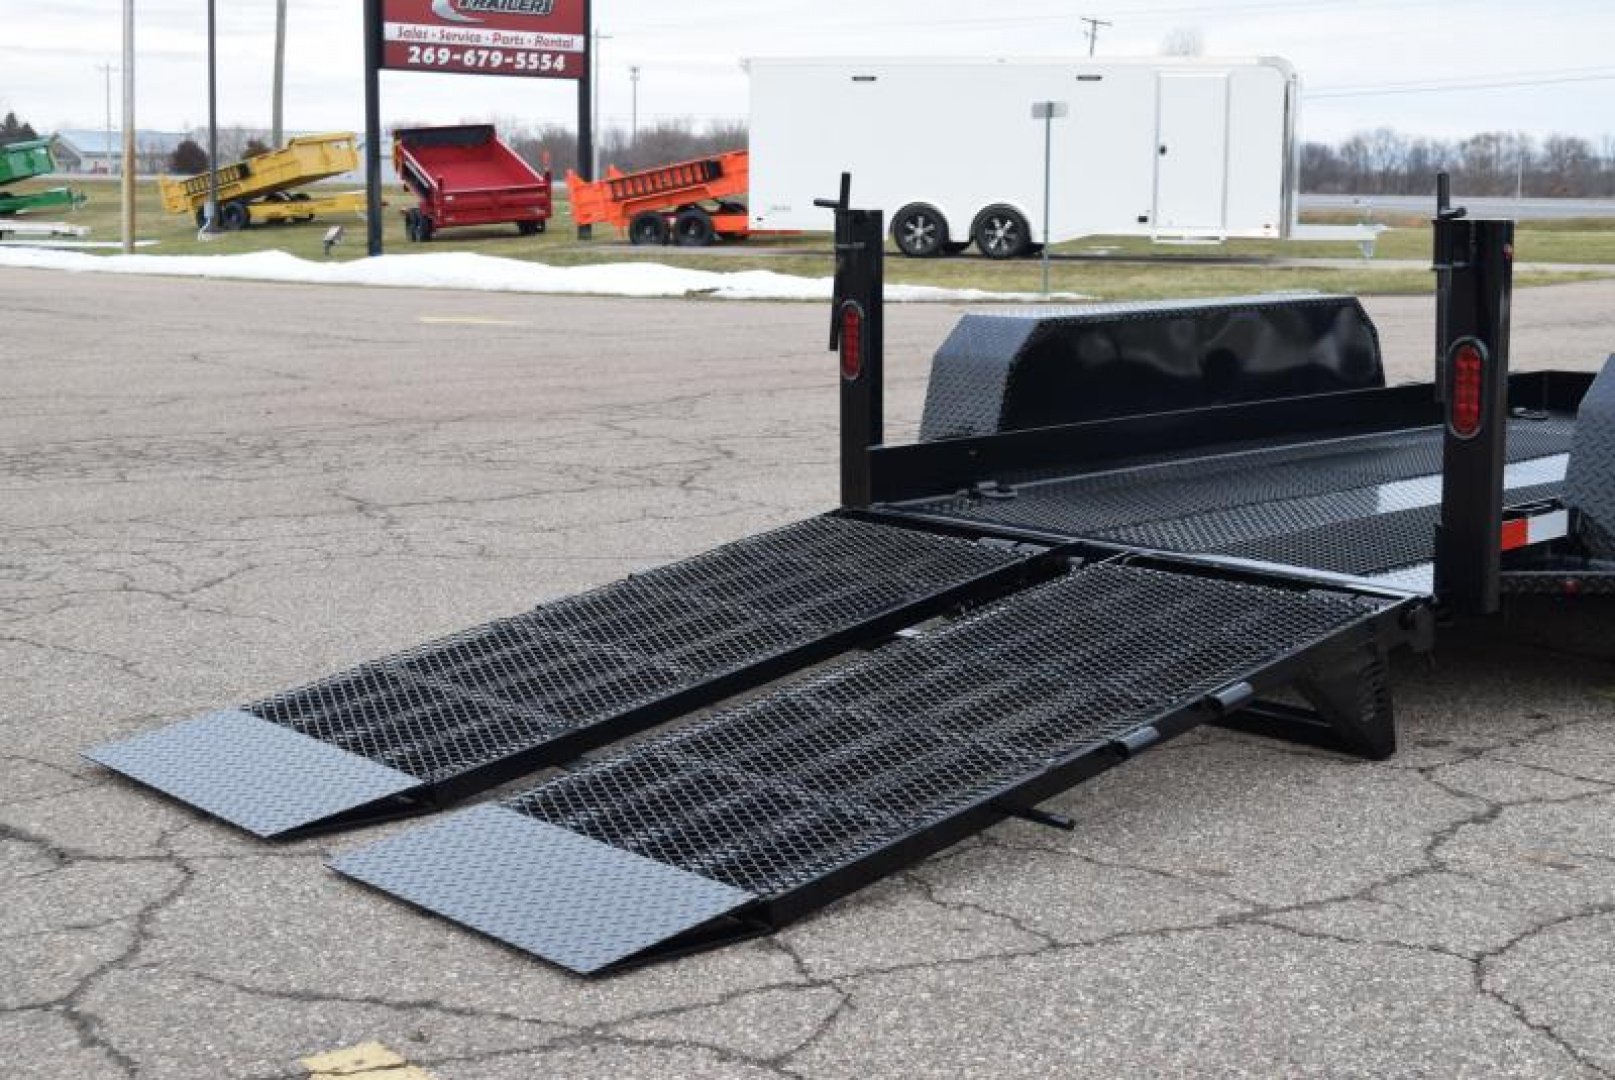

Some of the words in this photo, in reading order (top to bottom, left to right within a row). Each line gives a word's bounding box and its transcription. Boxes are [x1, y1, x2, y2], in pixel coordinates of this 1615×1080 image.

[397, 26, 428, 39] Sales
[439, 29, 481, 43] Service
[492, 33, 524, 45] Parts
[535, 35, 574, 48] Rental
[407, 46, 565, 71] 269-679-5554
